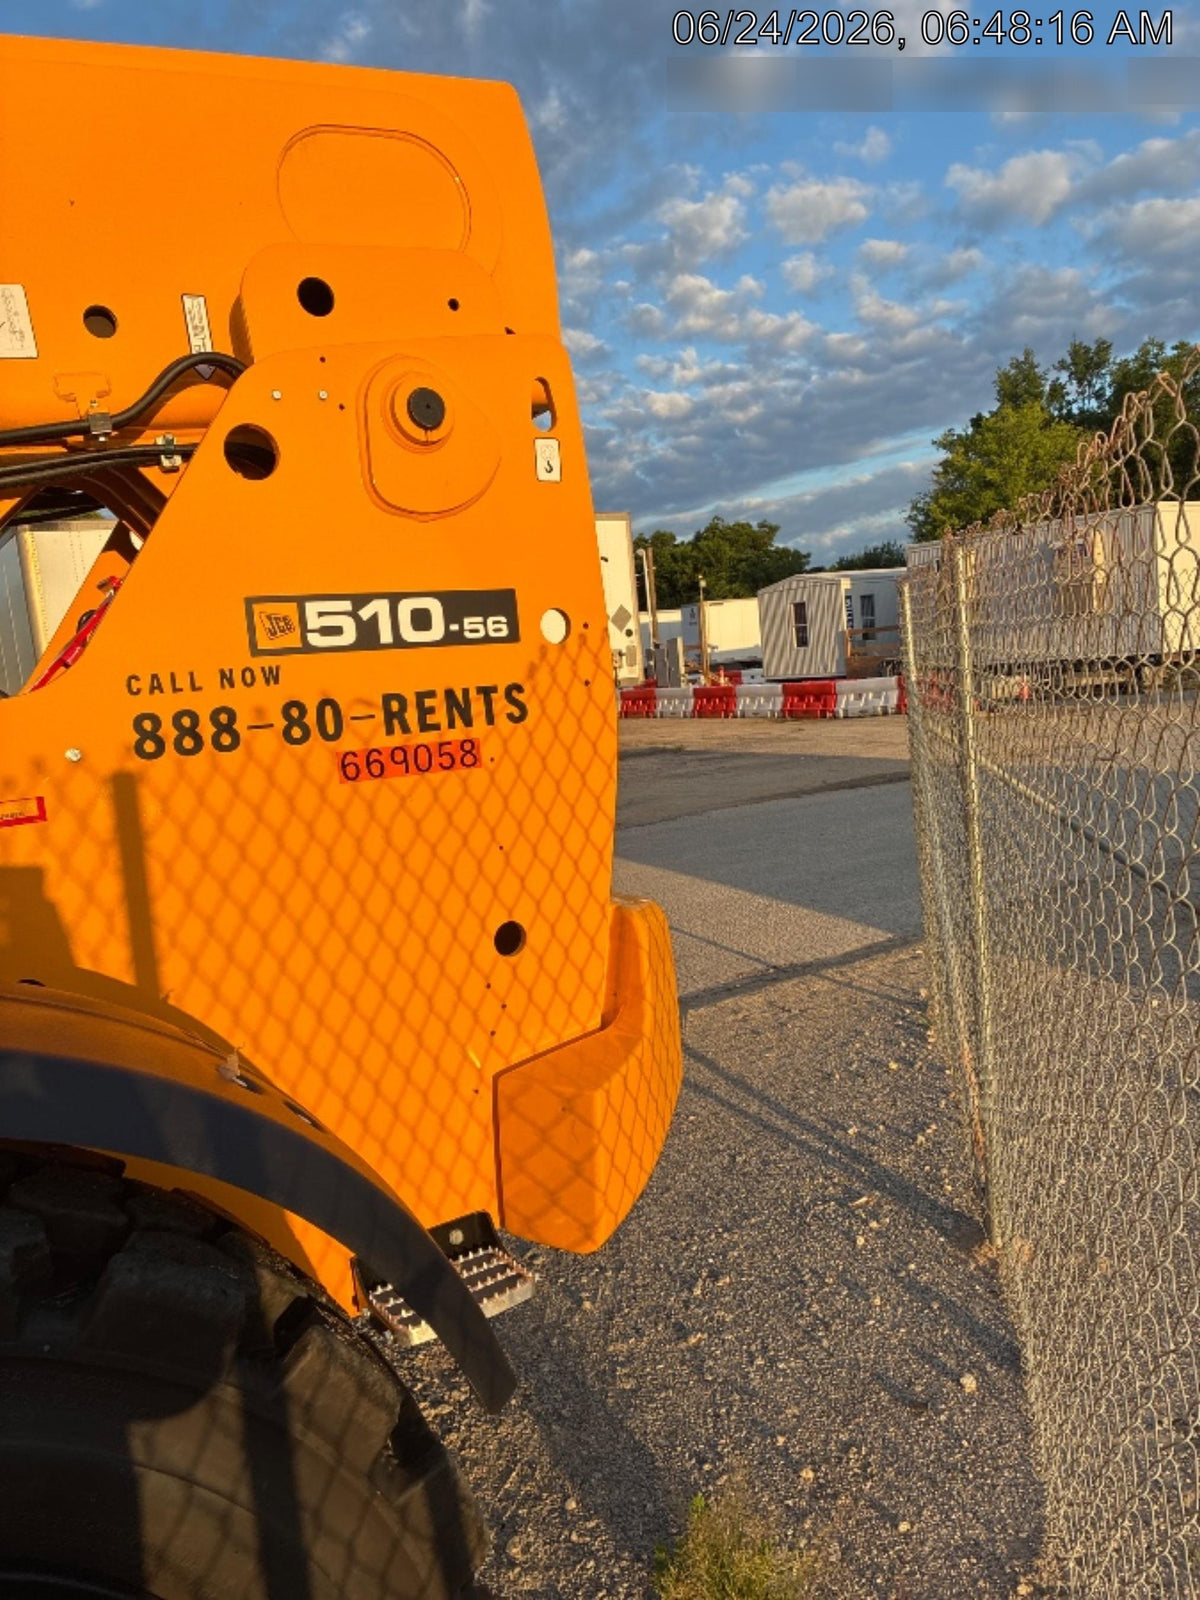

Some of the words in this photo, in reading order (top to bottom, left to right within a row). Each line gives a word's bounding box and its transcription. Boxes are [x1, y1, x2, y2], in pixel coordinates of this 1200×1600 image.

[305, 596, 509, 648] 510-56
[126, 671, 203, 696] CALL
[218, 665, 281, 690] NOW
[132, 682, 529, 761] 888-80-RENTS
[340, 738, 479, 781] 669058
